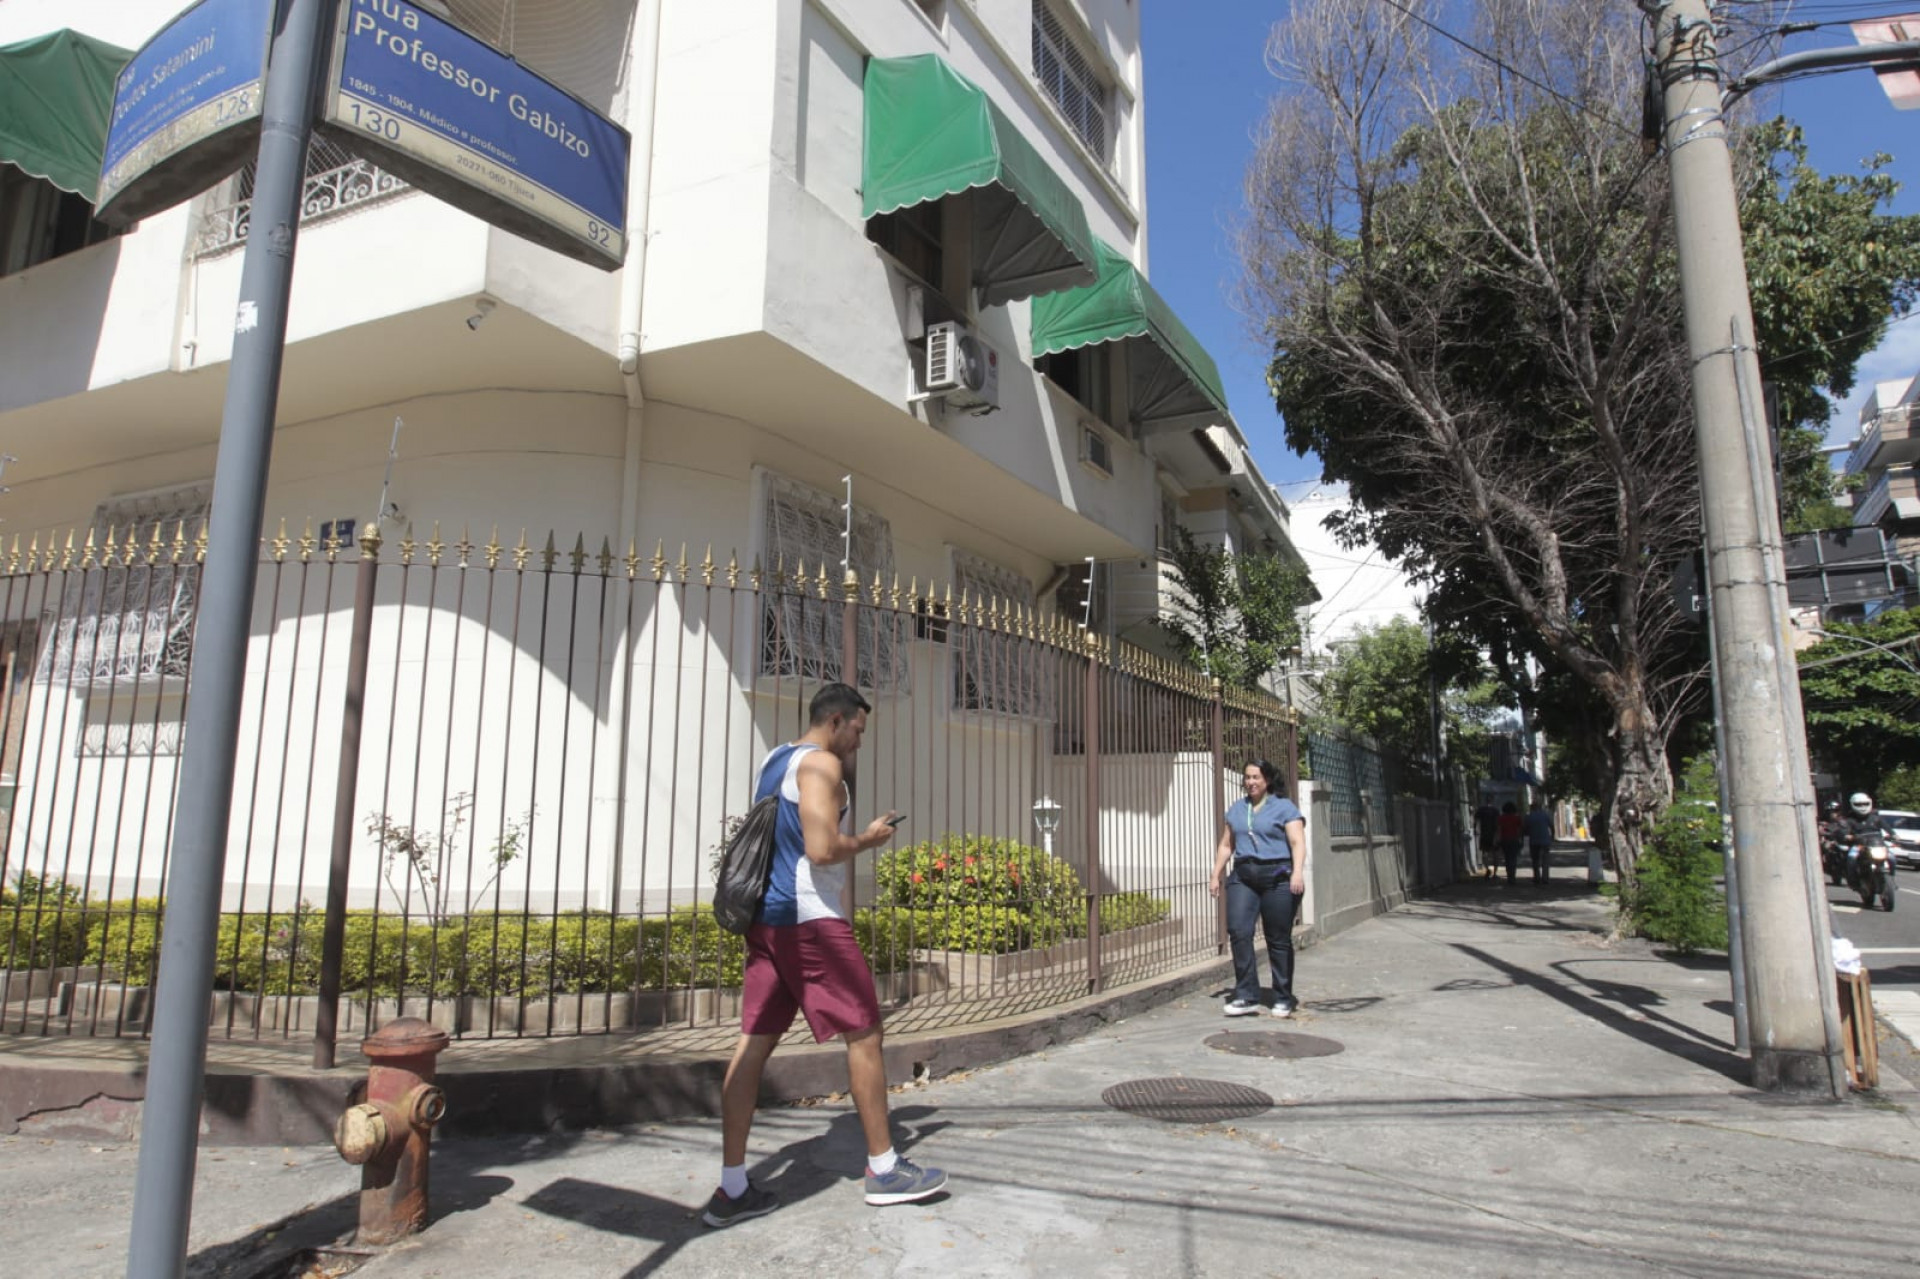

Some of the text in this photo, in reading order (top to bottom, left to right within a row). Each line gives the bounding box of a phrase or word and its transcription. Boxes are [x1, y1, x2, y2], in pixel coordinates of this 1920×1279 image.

[150, 27, 216, 90] Satamini
[349, 76, 376, 96] 1845
[354, 11, 590, 158] Professor Gabizo
[350, 103, 401, 141] 130
[588, 220, 610, 248] 92
